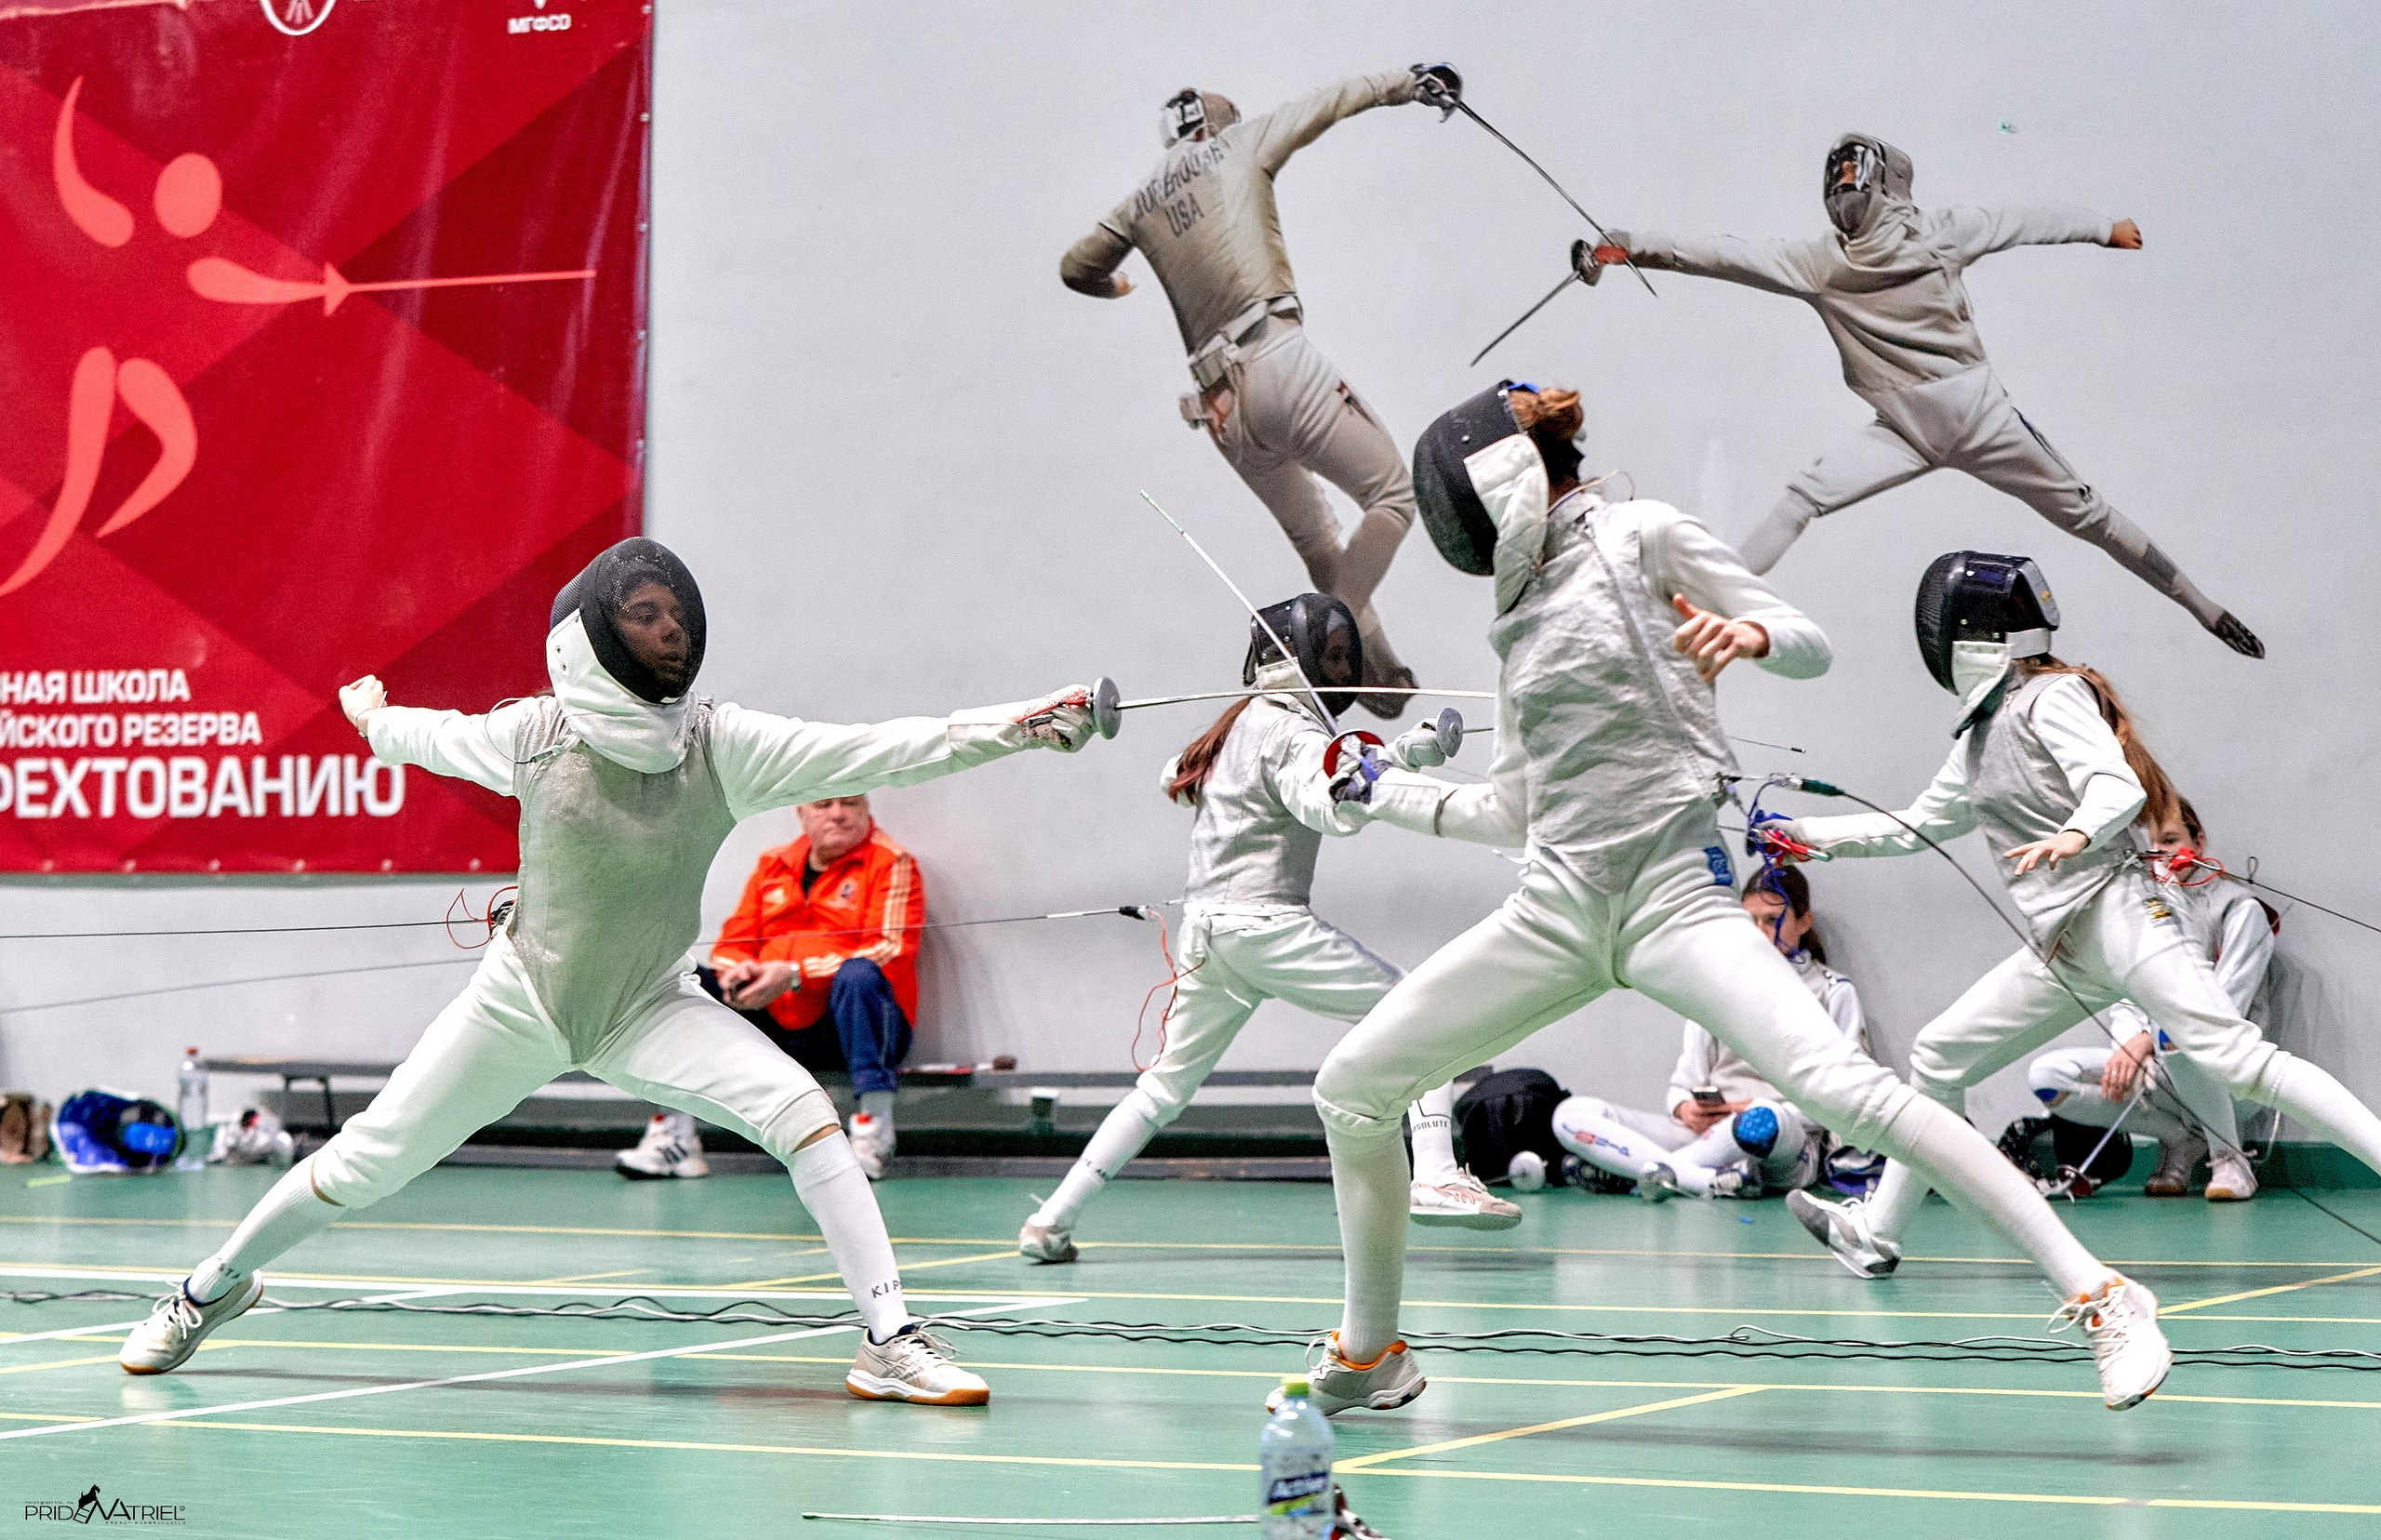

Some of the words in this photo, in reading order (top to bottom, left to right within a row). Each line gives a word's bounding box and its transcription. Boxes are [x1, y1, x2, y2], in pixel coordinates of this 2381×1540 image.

[1165, 192, 1205, 238] USA
[1, 670, 66, 705] НАЯ
[72, 669, 192, 704] ШКОЛА
[123, 711, 263, 747] РЕЗЕРВА
